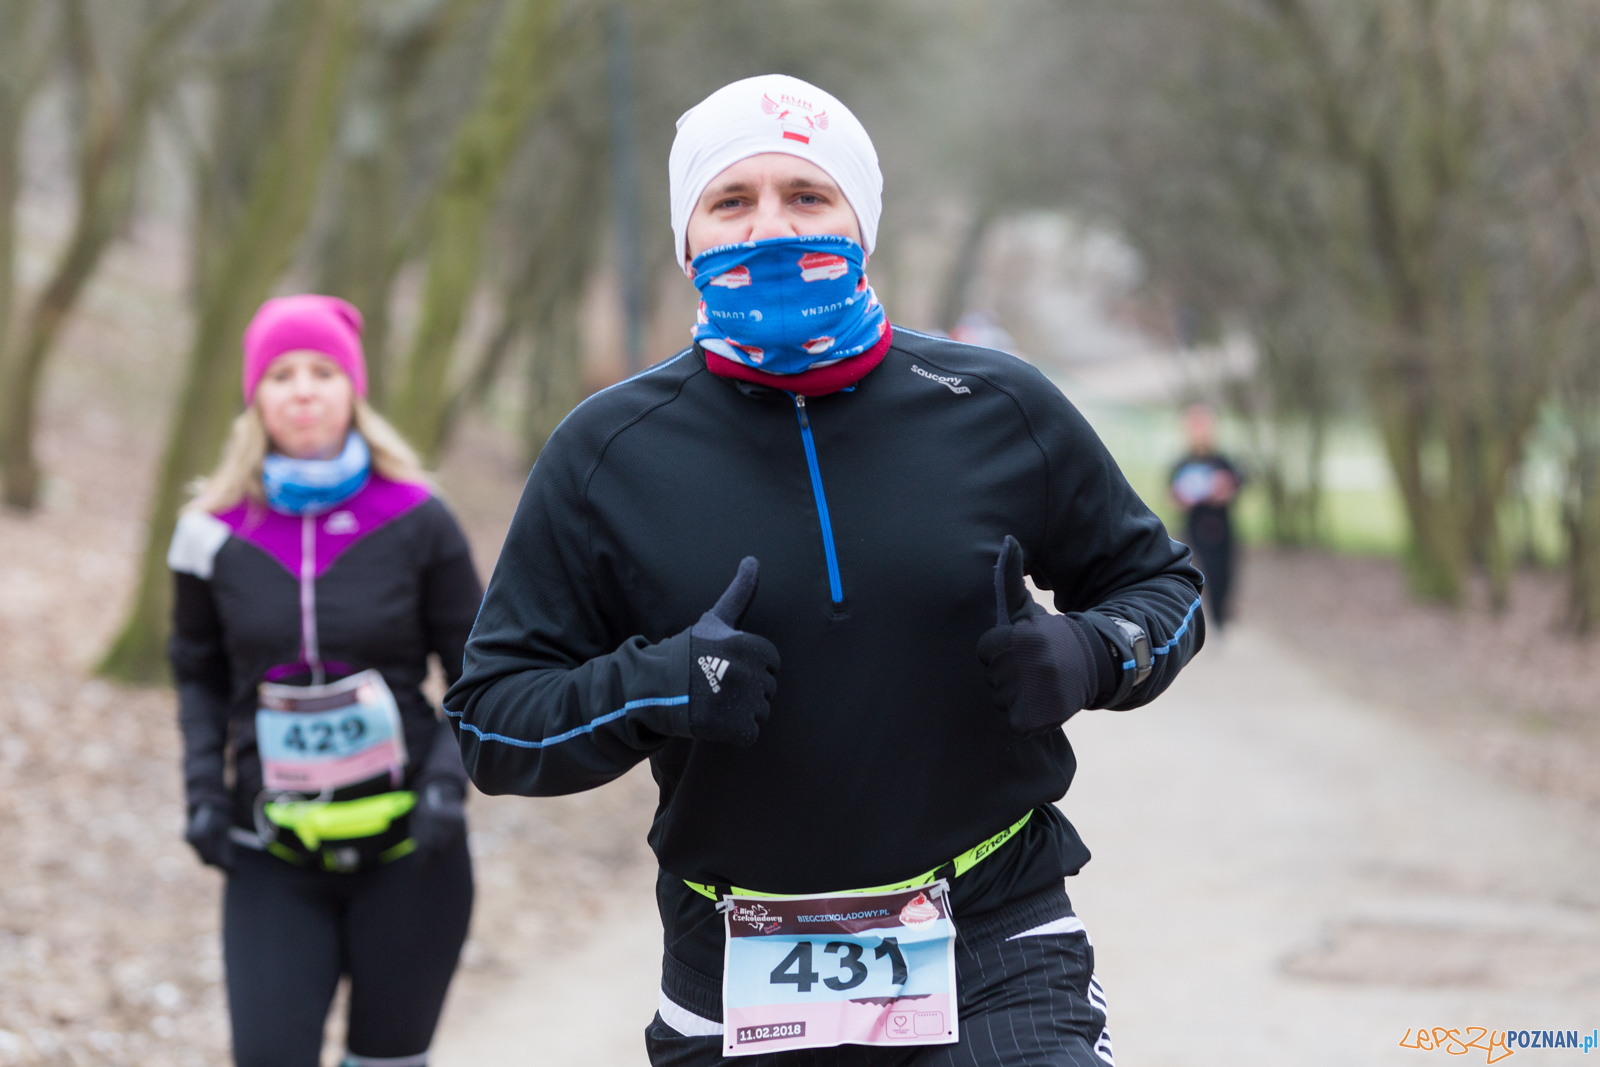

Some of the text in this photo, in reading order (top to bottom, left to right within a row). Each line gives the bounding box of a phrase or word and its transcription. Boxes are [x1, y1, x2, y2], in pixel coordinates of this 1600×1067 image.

[702, 243, 739, 257] LUVENA
[712, 310, 745, 319] LUVENA
[801, 302, 842, 317] LUVENA
[910, 364, 962, 386] saucony
[697, 656, 721, 694] adidas
[284, 716, 367, 753] 429
[732, 914, 783, 923] Czekoladowy
[739, 907, 754, 917] Bieg
[797, 908, 890, 923] BIEGCZEKOLADOWY.PL
[769, 936, 908, 993] 431
[740, 1024, 801, 1041] 11.02.2018
